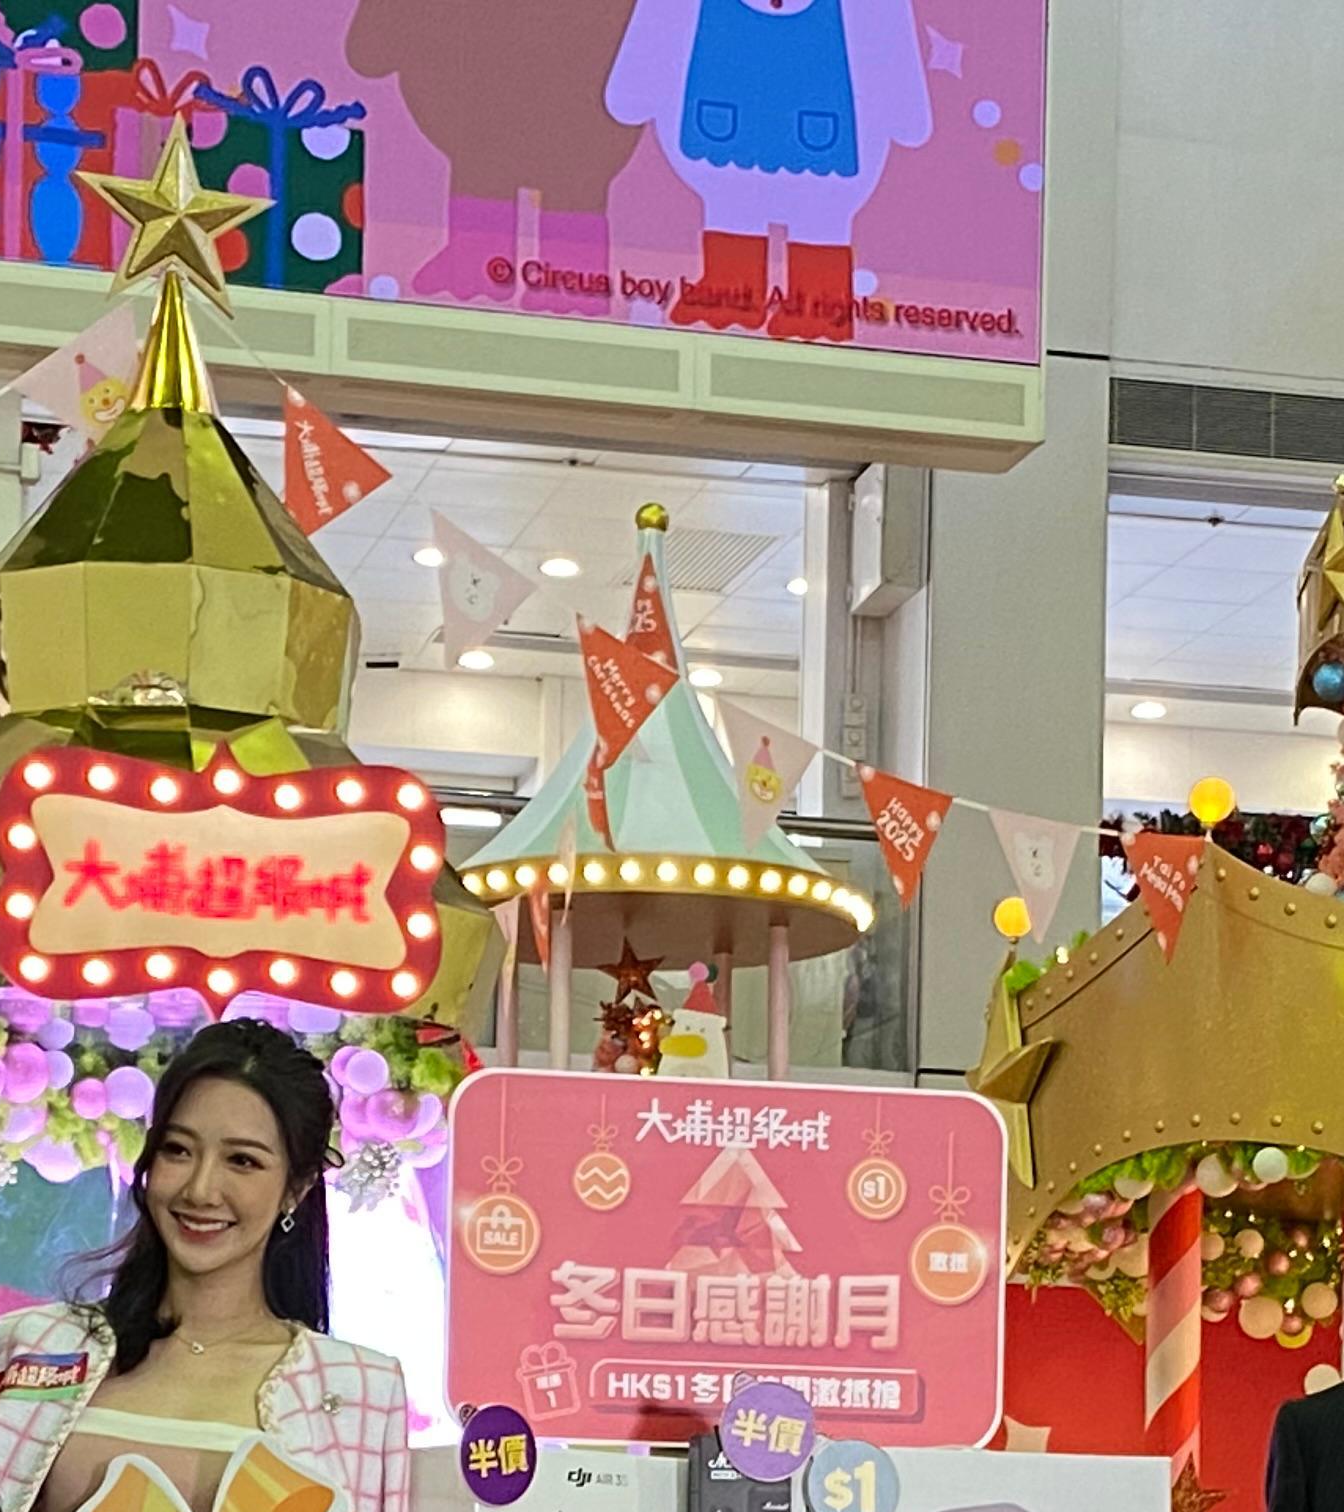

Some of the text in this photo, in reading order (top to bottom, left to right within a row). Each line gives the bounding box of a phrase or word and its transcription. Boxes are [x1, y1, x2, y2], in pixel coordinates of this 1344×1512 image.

[522, 259, 611, 297] Circus
[620, 269, 670, 306] boy
[894, 302, 1023, 336] reserved.
[602, 657, 636, 708] Merry
[876, 809, 916, 862] 2025
[886, 796, 925, 848] Happy
[635, 1096, 832, 1152] 大埔超級城
[483, 1229, 519, 1248] SALE
[549, 1260, 902, 1351] 冬日感謝月
[468, 1433, 532, 1477] 半價
[730, 1407, 806, 1457] 半價
